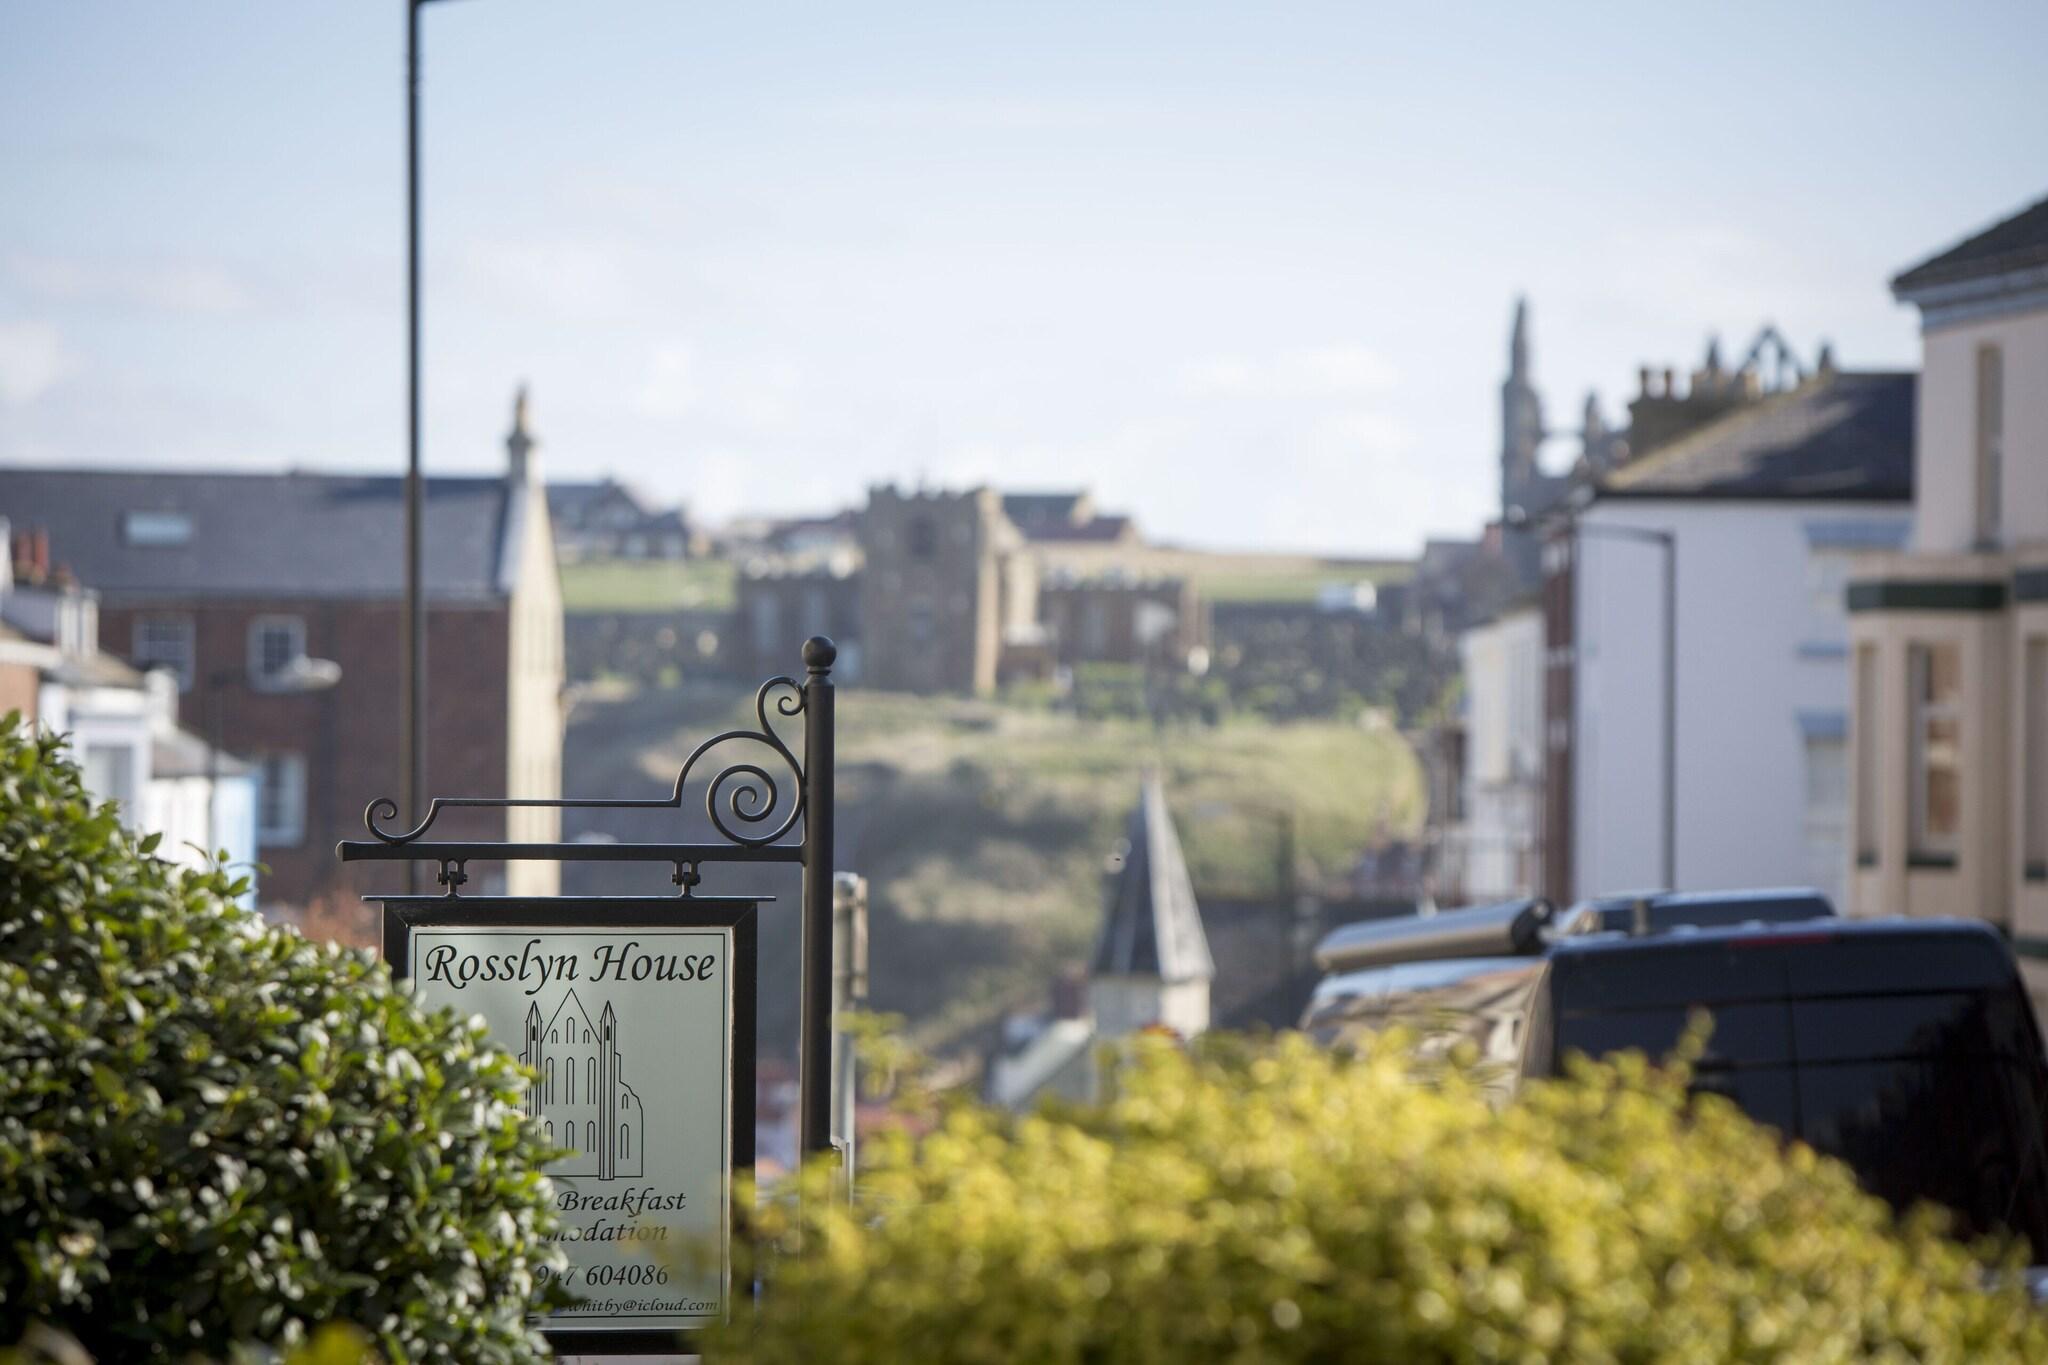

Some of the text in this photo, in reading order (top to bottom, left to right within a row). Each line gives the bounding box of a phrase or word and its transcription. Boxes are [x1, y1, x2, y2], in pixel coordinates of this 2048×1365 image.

[426, 939, 716, 995] Rosslyn House
[557, 1187, 687, 1218] Breakfast
[586, 1264, 669, 1287] 604086
[567, 1297, 718, 1316] whitby@icloud.com
